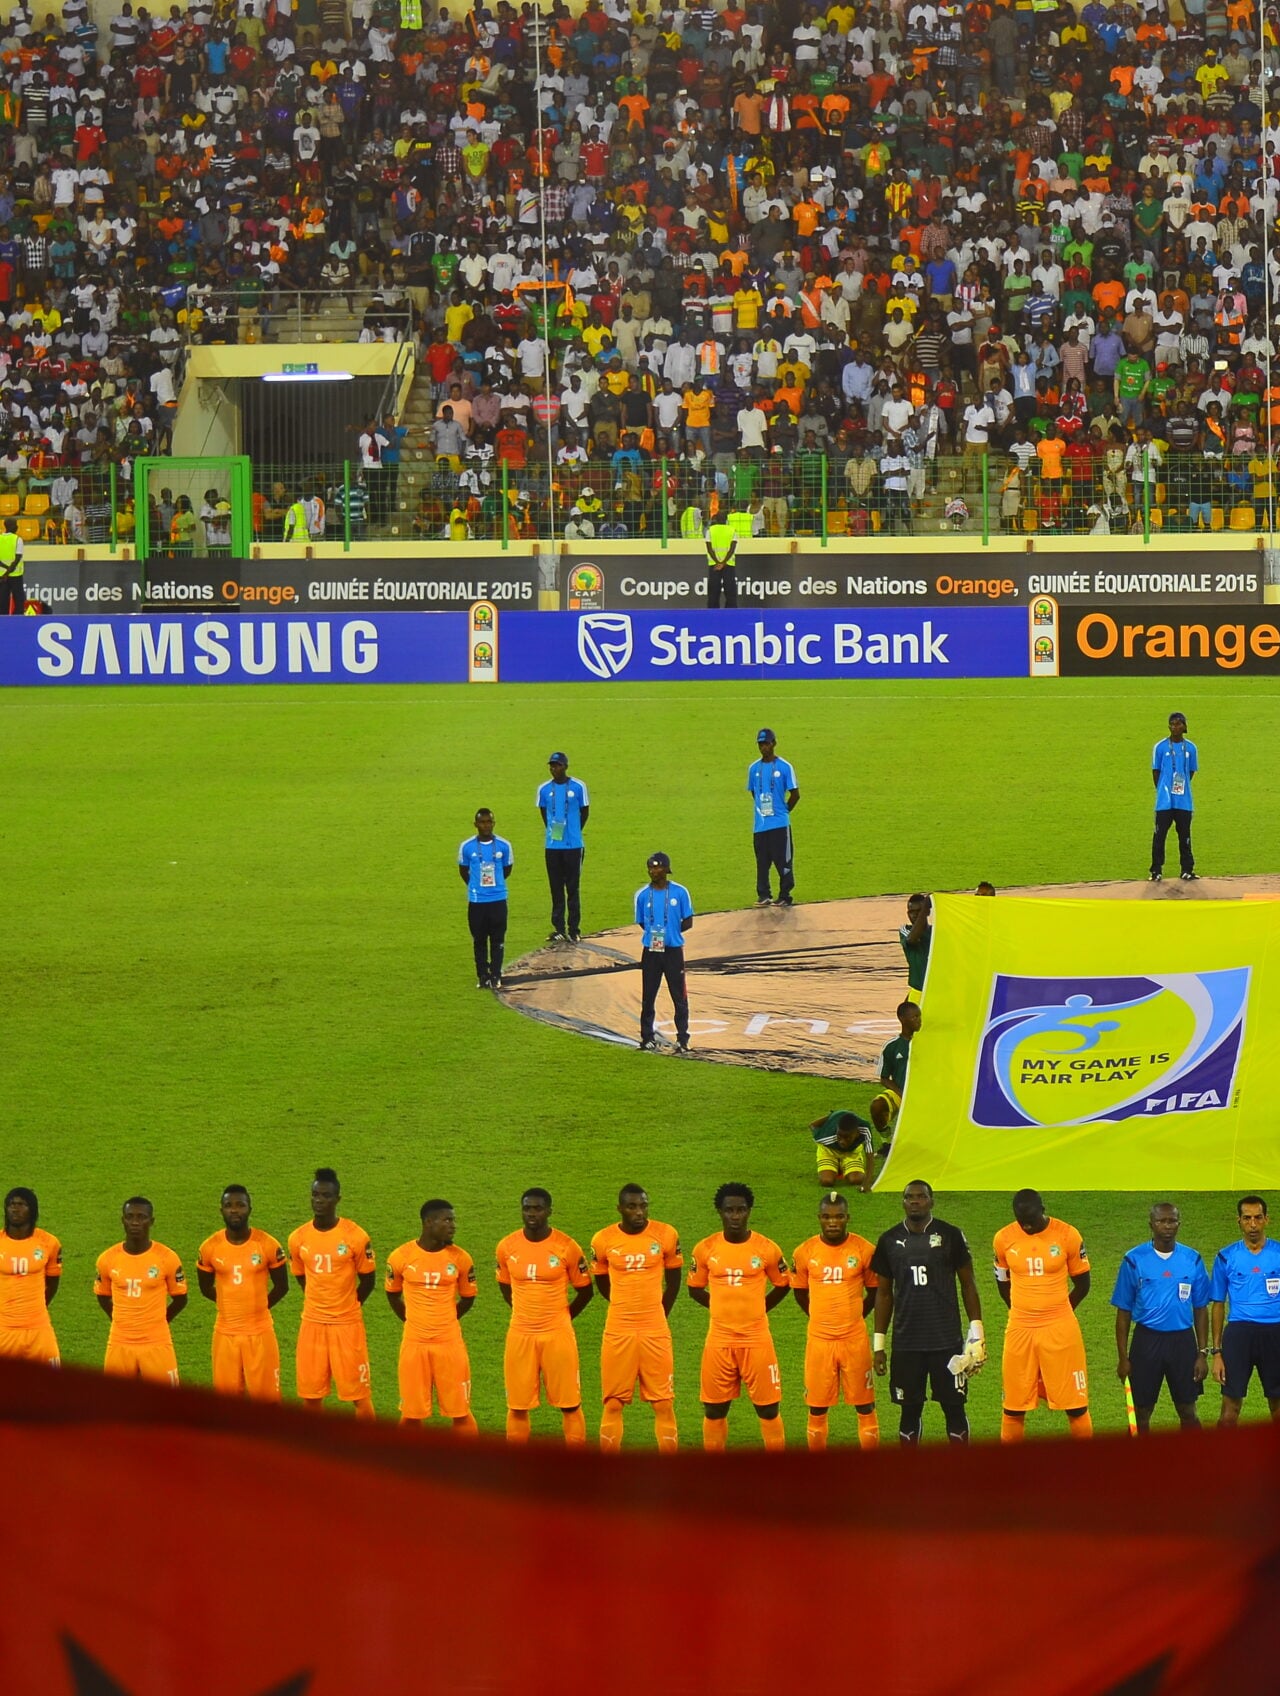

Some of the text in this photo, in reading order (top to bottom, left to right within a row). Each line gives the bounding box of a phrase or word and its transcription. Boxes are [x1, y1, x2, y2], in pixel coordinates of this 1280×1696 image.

[85, 583, 123, 601] des
[132, 581, 214, 600] Nations
[308, 578, 369, 600] GUINÉE
[373, 578, 488, 601] ÉQUATORIALE
[491, 581, 533, 600] 2015
[620, 577, 689, 600] Coupe
[799, 576, 837, 595] des
[847, 576, 928, 595] Nations
[935, 575, 1019, 598] Orange,
[1028, 571, 1090, 594] GUINÉE
[1094, 570, 1211, 594] ÉQUATORIALE
[1215, 574, 1257, 593] 2015
[37, 620, 378, 677] SAMSUNG
[650, 621, 949, 665] Stanbic Bank
[1076, 613, 1280, 669] Orange
[1022, 1052, 1171, 1071] MY GAME IS
[1020, 1070, 1140, 1085] FAIR PLAY
[1144, 1089, 1222, 1112] FIFA
[11, 1257, 28, 1275] 10
[314, 1254, 332, 1273] 21
[625, 1254, 646, 1271] 22
[1026, 1257, 1044, 1276] 19
[233, 1265, 243, 1285] 5
[526, 1264, 537, 1282] 4
[727, 1268, 744, 1287] 12
[823, 1267, 843, 1284] 20
[910, 1266, 927, 1286] 16
[126, 1279, 142, 1298] 15
[1072, 1370, 1087, 1390] 19
